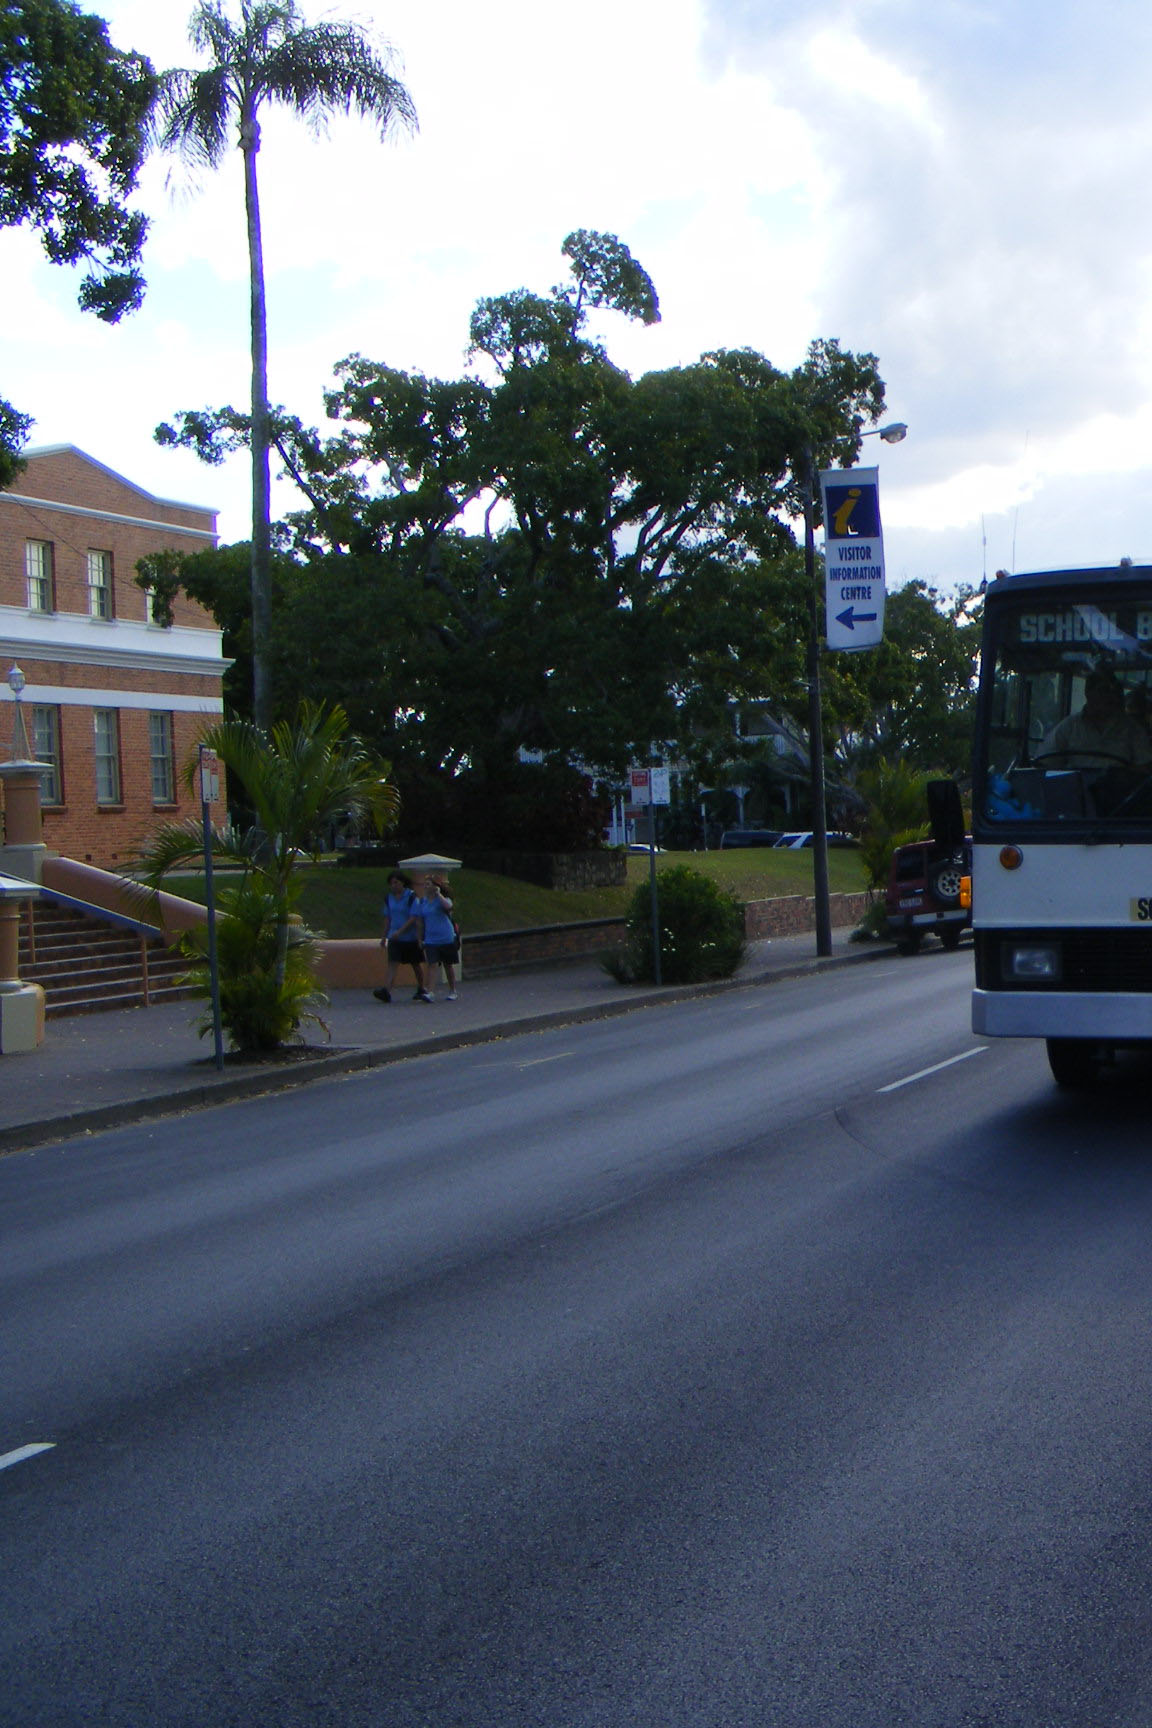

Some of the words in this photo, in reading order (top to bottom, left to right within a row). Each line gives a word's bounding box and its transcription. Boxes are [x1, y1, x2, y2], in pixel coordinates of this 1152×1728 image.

[838, 546, 872, 561] VISITOR
[829, 566, 882, 581] INFORMATION
[840, 586, 872, 601] CENTRE
[1020, 611, 1124, 642] SCHOOL
